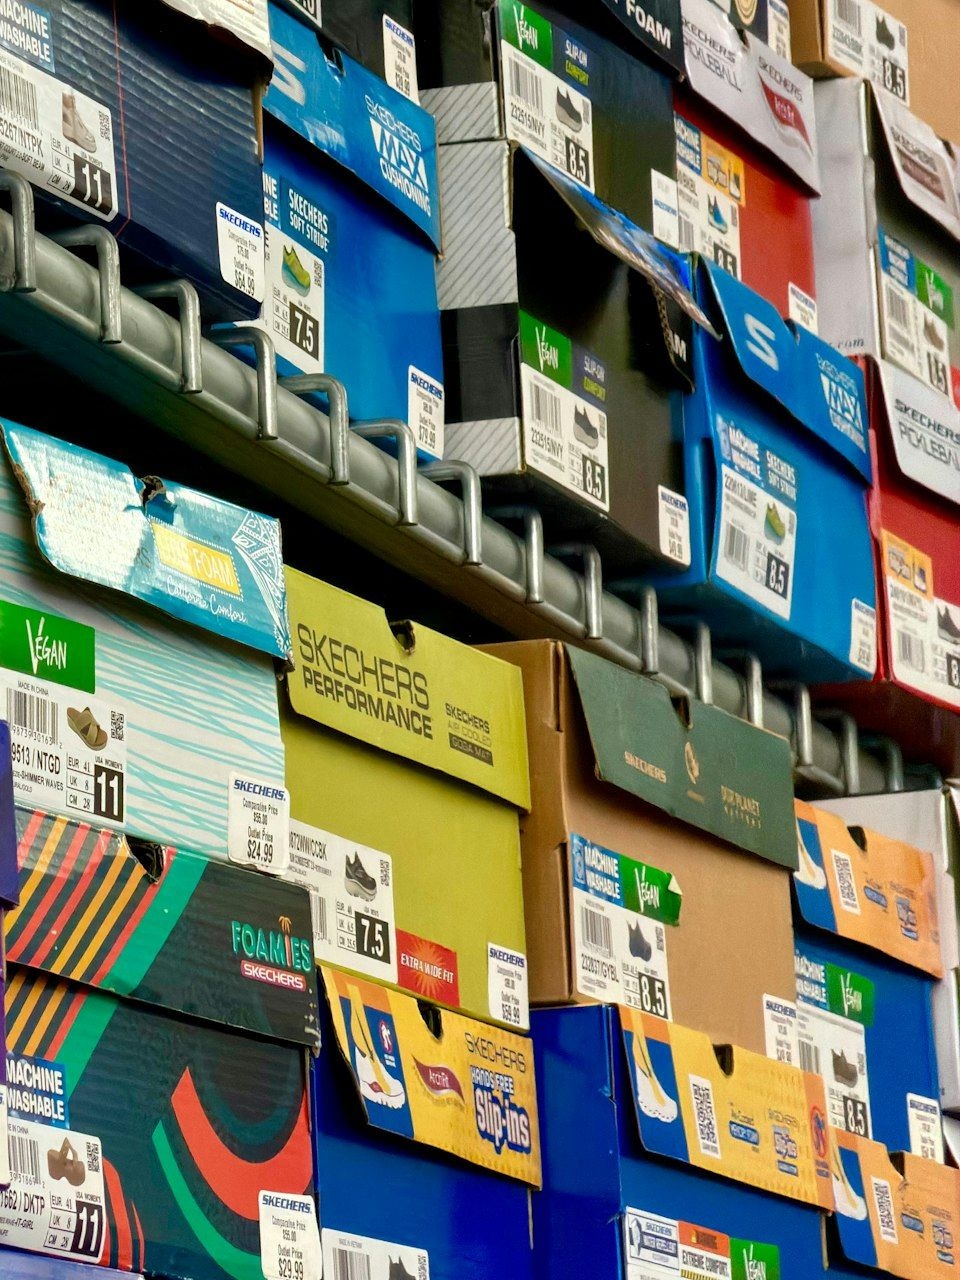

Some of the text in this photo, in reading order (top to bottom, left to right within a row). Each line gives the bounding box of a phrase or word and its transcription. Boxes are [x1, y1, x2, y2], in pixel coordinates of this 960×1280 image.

[365, 94, 422, 152] SKECHERS
[369, 115, 429, 192] MAX
[379, 157, 431, 218] CUSHIONING
[219, 206, 263, 239] SKECHERS
[288, 186, 330, 235] SKECHERS
[234, 269, 256, 298] $64.99
[294, 310, 316, 356] 7.5
[534, 325, 559, 374] VEGAN
[410, 372, 445, 400] SKECHERS
[893, 396, 960, 447] SKECHERS
[585, 459, 603, 501] 8.5
[191, 546, 236, 590] FOAM
[768, 552, 787, 594] 8.5
[25, 616, 68, 677] VEGAN
[296, 622, 431, 712] SKECHERS
[303, 665, 434, 741] PERFORMANCE
[444, 701, 491, 735] SKECHERS
[35, 750, 61, 776] NTGD
[67, 756, 81, 769] EUR
[624, 750, 668, 785] SKECHERS
[69, 774, 79, 788] UK
[232, 778, 287, 803] SKECHERS
[68, 794, 79, 808] CM
[242, 796, 280, 817] Comparative Price
[247, 825, 274, 844] Outlet Price
[246, 839, 274, 865] $24.99
[583, 845, 620, 880] MACHINE
[230, 919, 313, 973] FOAMIES
[361, 917, 386, 961] 7.5
[400, 951, 455, 985] EXTRA WIDE FIT
[489, 947, 526, 969] SKECHERS
[243, 963, 304, 991] SKECHERS
[640, 973, 666, 1016] 8.5
[464, 1030, 527, 1073] SKECHERS
[6, 1058, 64, 1097] MACHINE
[7, 1088, 66, 1122] WASHABLE
[475, 1086, 531, 1154] Slip-ins
[23, 1193, 46, 1214] DKTP
[51, 1194, 64, 1207] EUR
[261, 1193, 313, 1215] SKECHERS
[294, 1221, 307, 1233] Price
[277, 1245, 304, 1260] Outlet Price
[277, 1257, 304, 1280] $29.99
